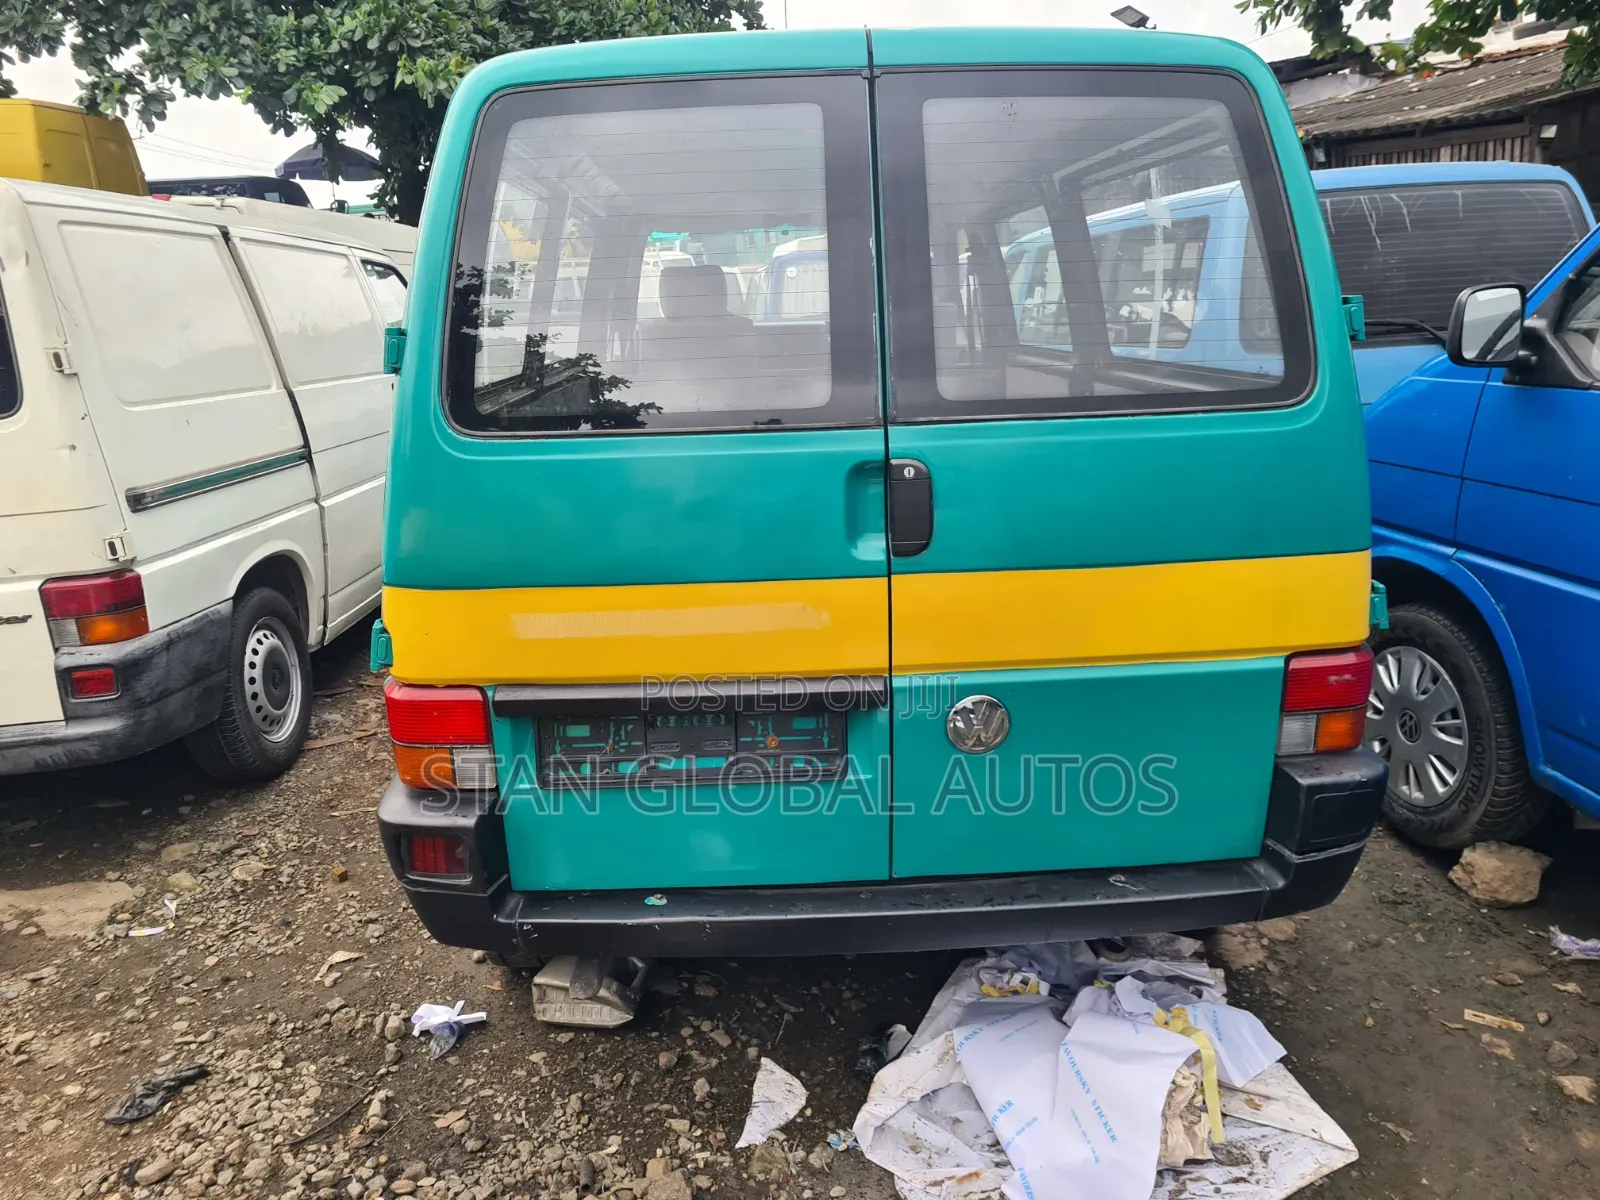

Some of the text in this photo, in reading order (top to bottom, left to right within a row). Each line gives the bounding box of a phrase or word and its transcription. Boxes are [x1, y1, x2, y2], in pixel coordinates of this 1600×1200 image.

[1458, 715, 1488, 815] SNOWTRAC
[956, 1026, 984, 1052] OURSKY
[1091, 1099, 1118, 1142] STICKER
